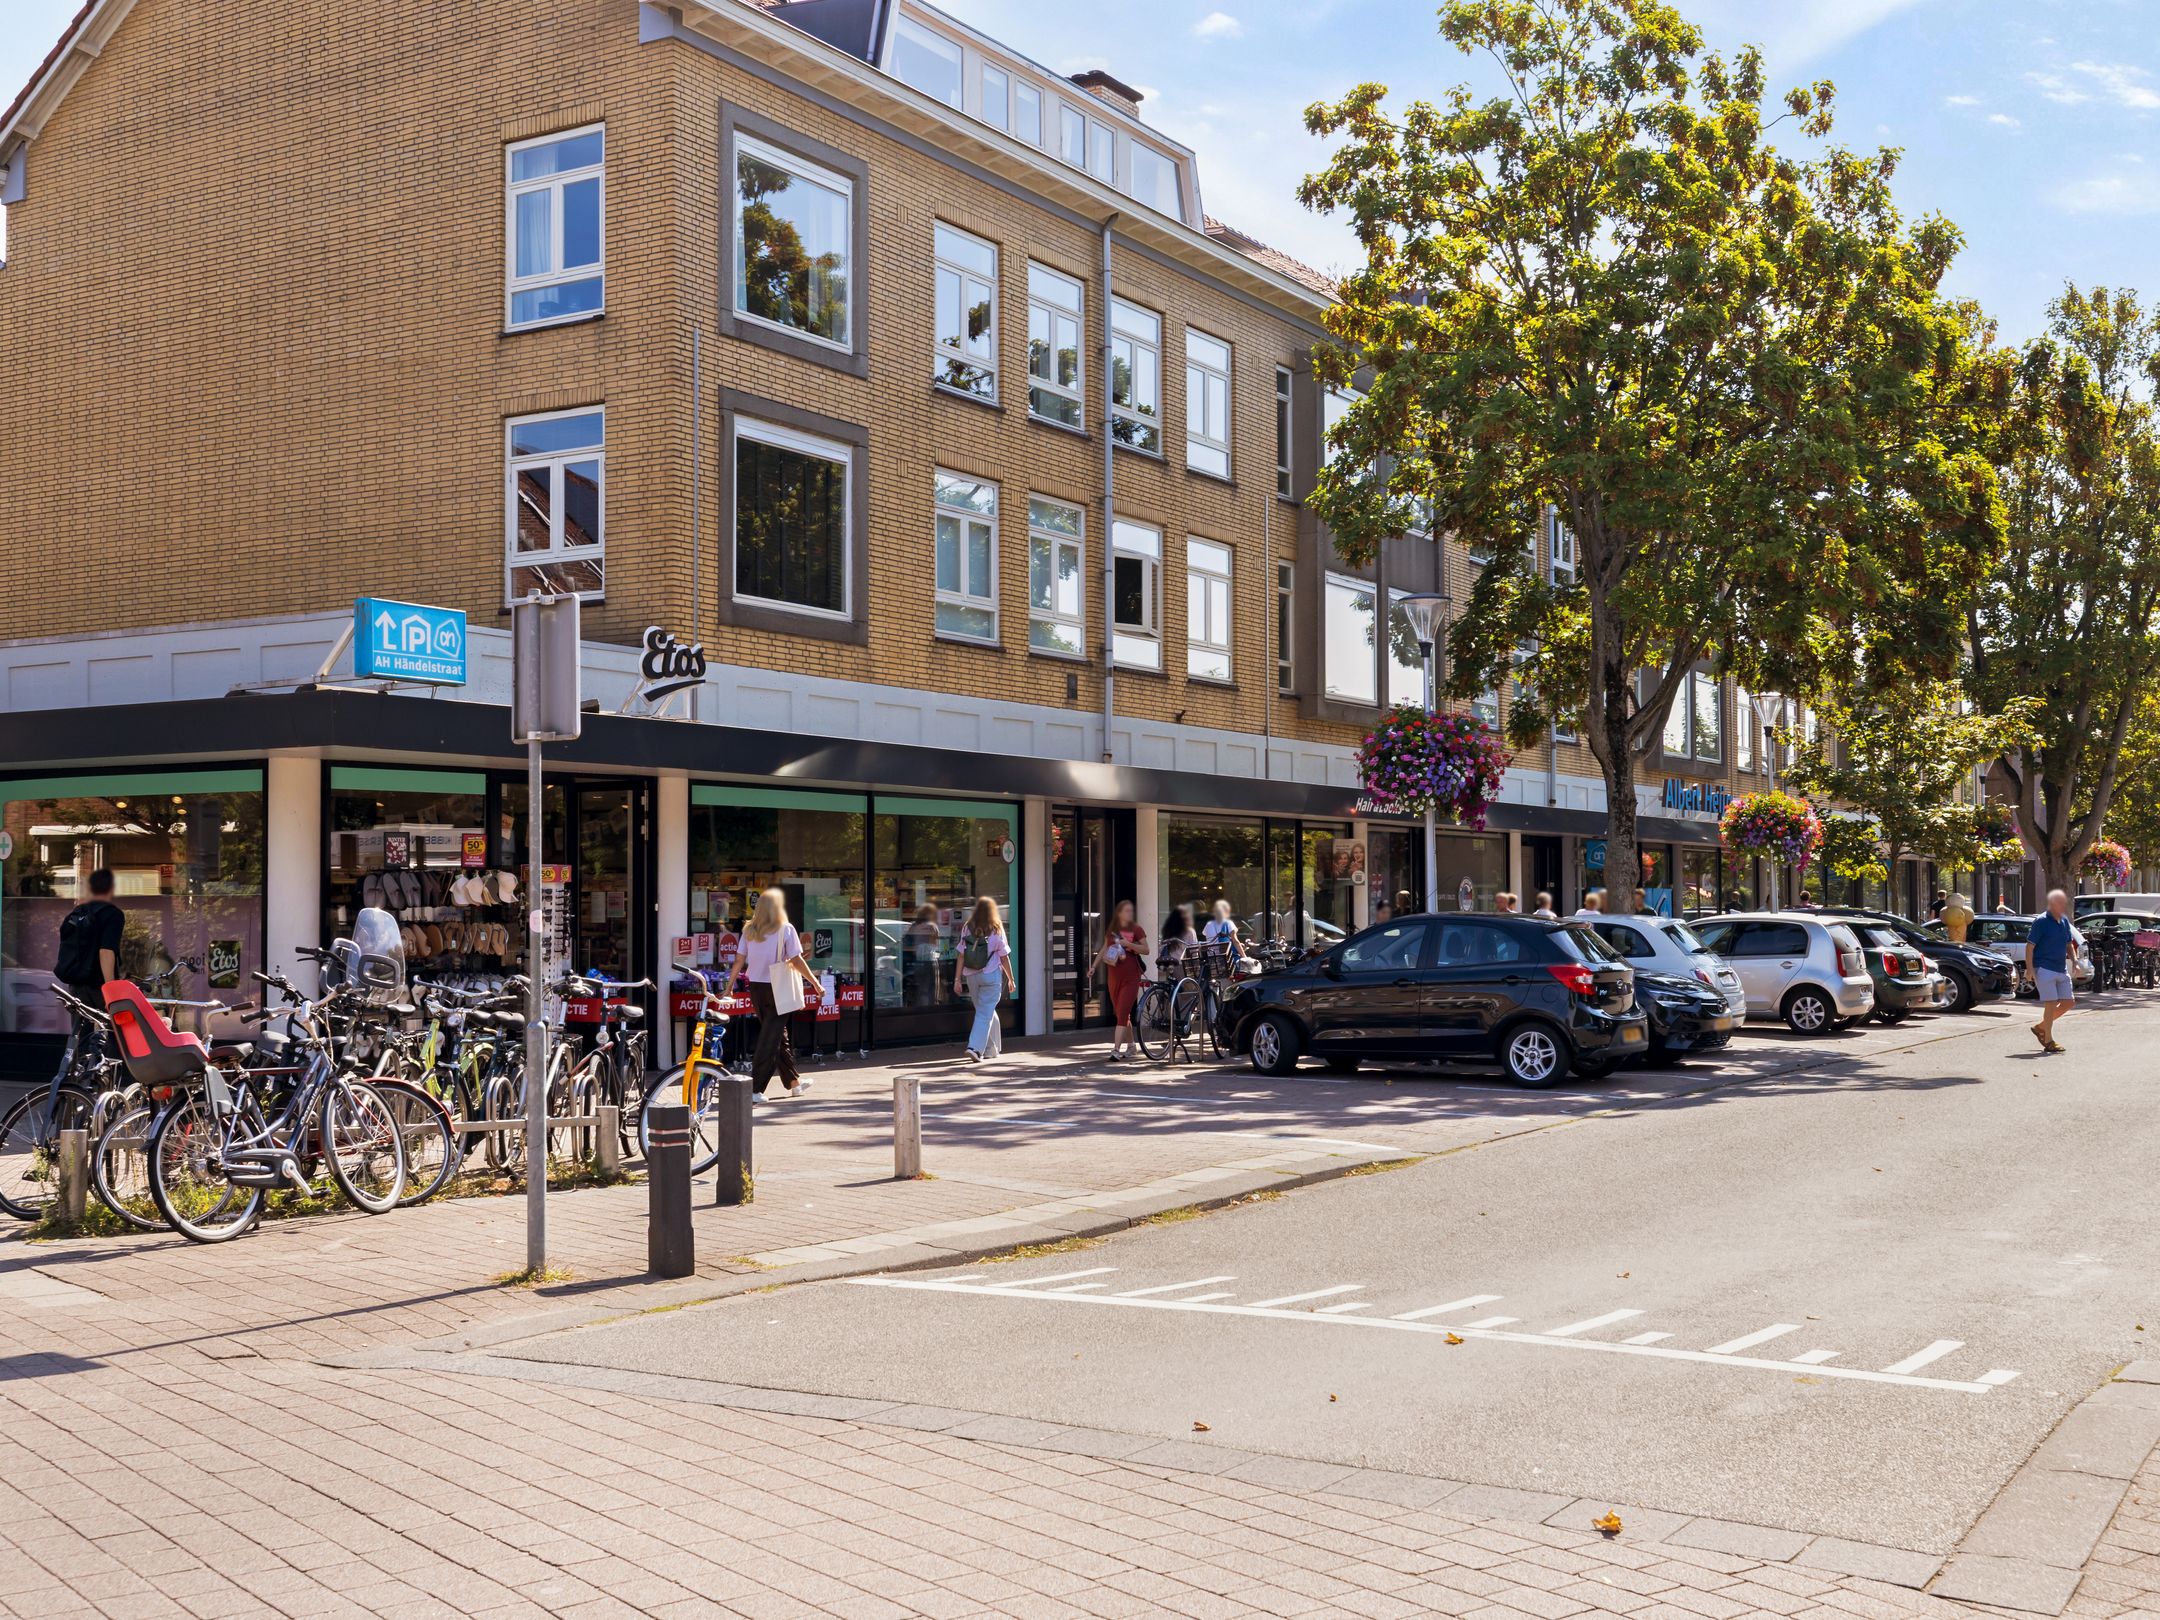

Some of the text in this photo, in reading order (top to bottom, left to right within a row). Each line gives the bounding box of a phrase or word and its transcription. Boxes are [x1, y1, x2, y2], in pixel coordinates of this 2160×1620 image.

[408, 626, 426, 653] P
[640, 626, 706, 681] Etos
[374, 655, 463, 676] AH Händelstraat
[1665, 778, 1701, 812] Albert
[720, 942, 738, 952] actie
[815, 933, 832, 949] Etos
[210, 947, 239, 971] Etos
[804, 994, 817, 1004] TIE
[841, 991, 864, 1001] ACTIE
[566, 1003, 588, 1015] CTIE
[679, 999, 704, 1010] ACTI
[817, 1004, 840, 1016] ACTIE
